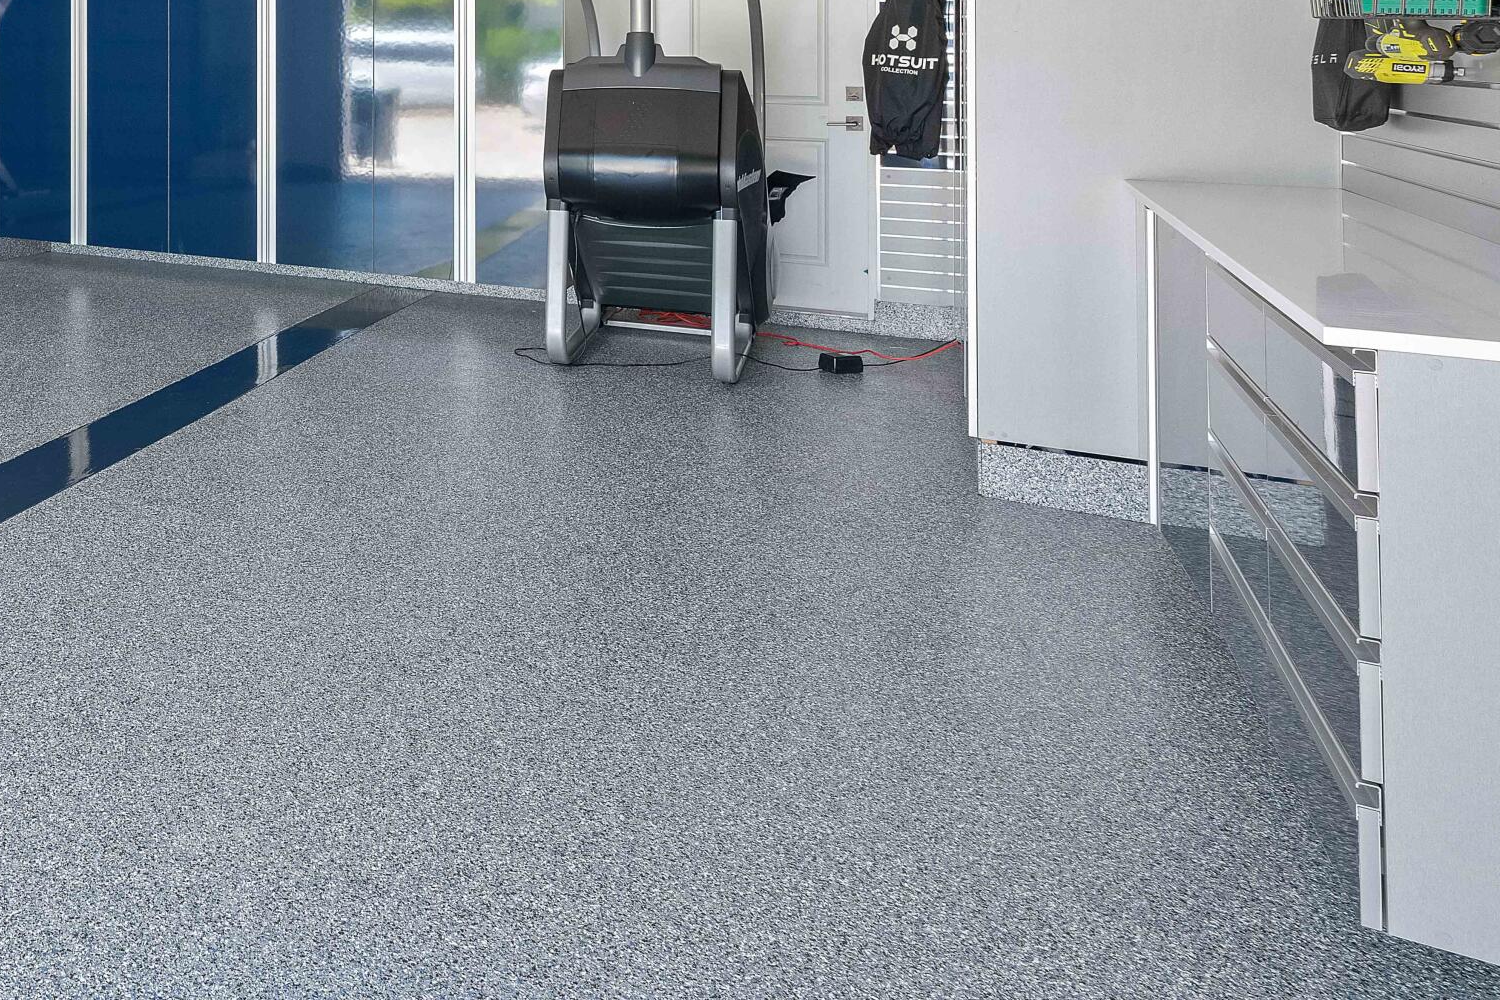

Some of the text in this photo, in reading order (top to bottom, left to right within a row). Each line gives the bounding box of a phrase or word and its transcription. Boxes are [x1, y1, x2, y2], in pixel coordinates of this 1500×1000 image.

[871, 53, 939, 70] HOTSUIT
[1311, 53, 1338, 65] SLA
[880, 66, 918, 76] COLLECTION
[1393, 63, 1425, 73] RYOBI
